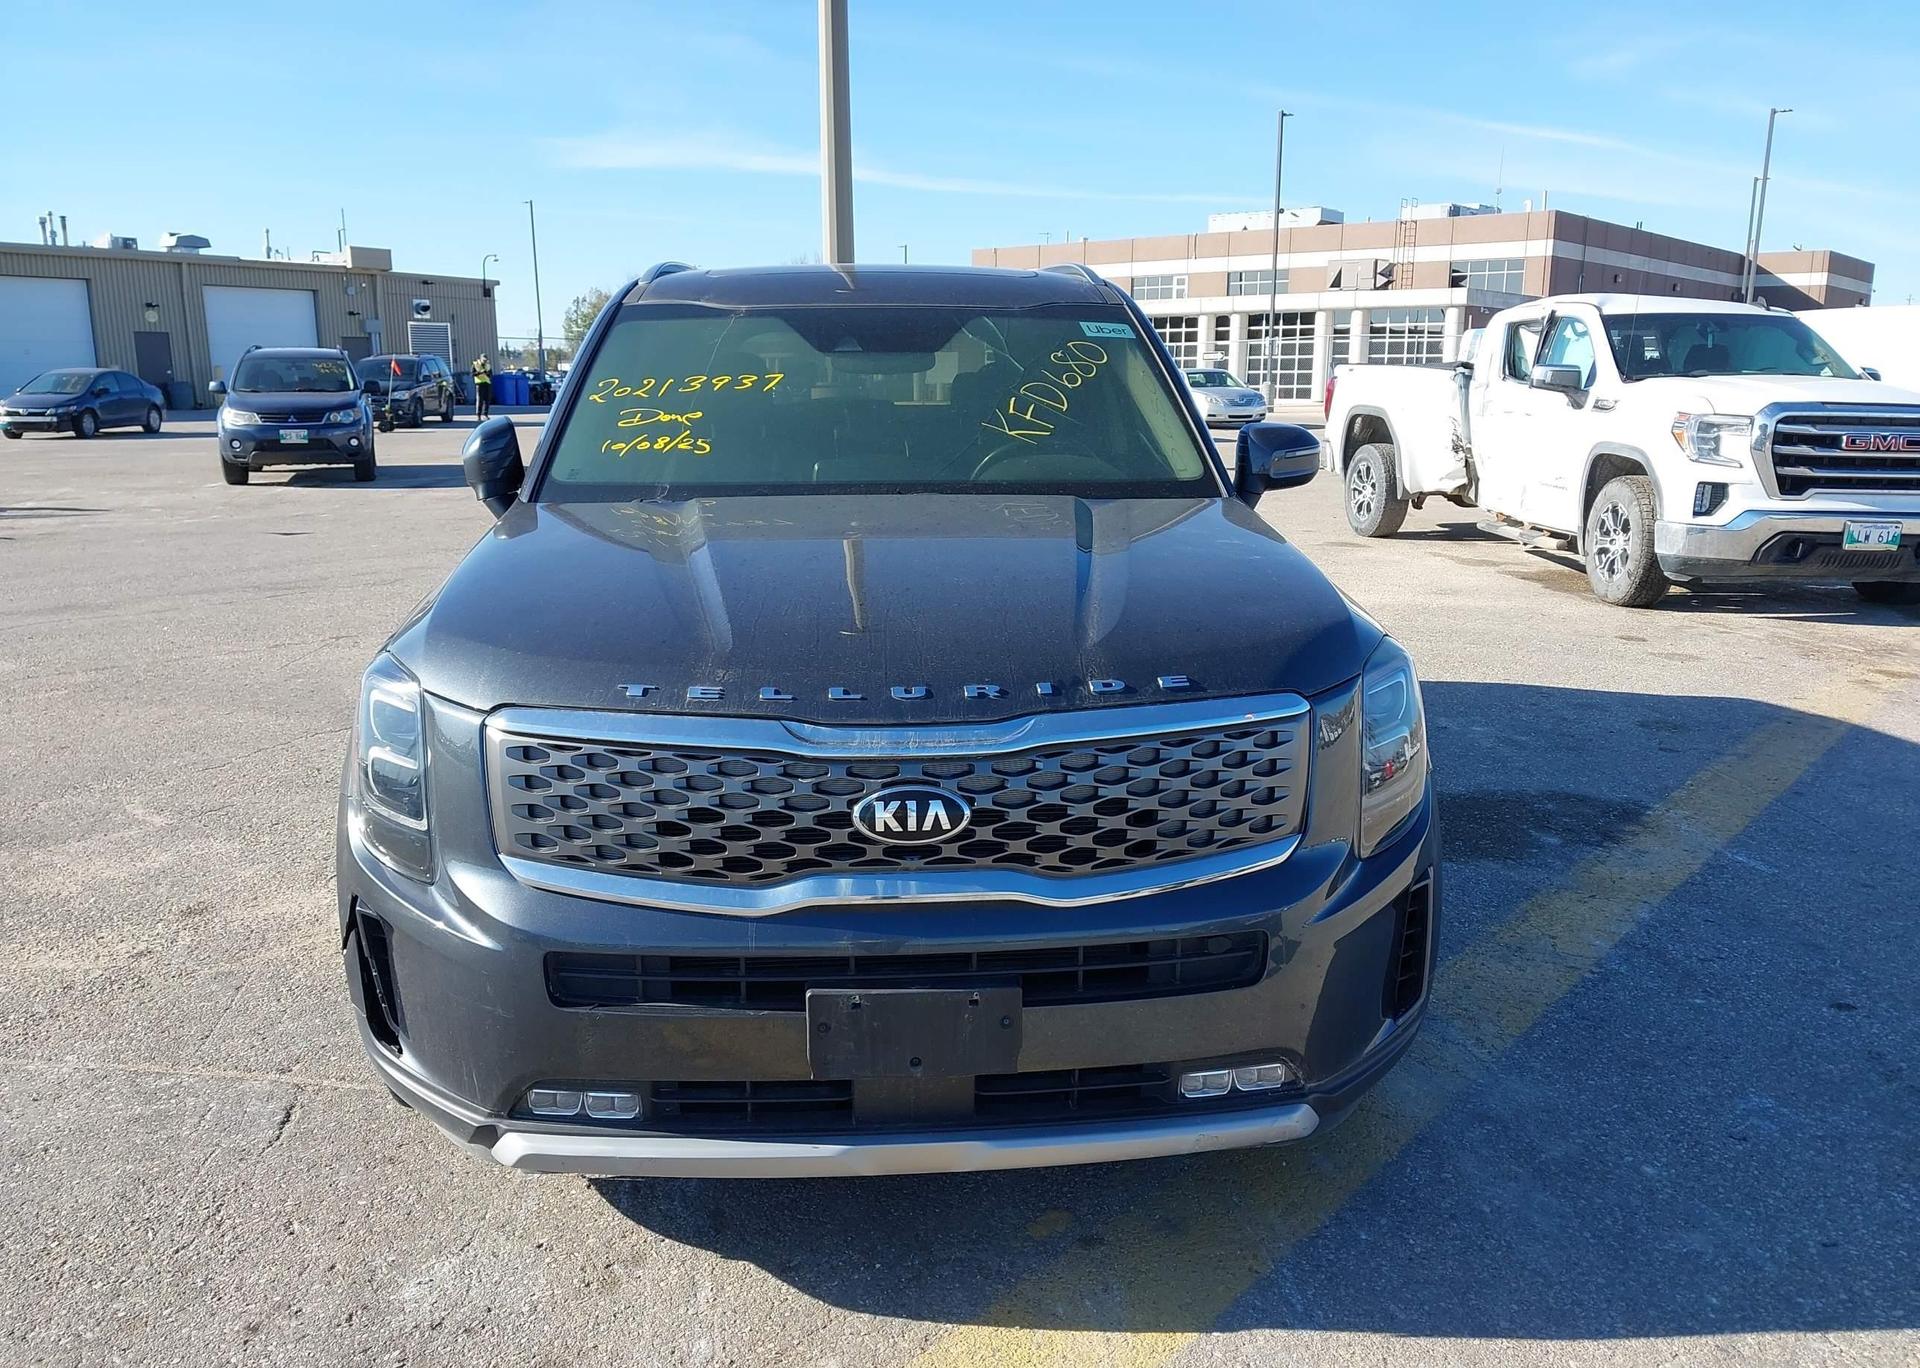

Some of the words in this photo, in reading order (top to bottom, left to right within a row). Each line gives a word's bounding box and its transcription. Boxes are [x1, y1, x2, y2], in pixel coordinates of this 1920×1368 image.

[1085, 324, 1128, 336] Uber
[588, 373, 785, 403] 20213937
[981, 341, 1108, 445] KFD680
[617, 408, 703, 427] Done
[601, 430, 711, 457] 10/08/25
[1842, 434, 1920, 451] GMC
[617, 674, 1191, 703] TELLURIDE
[873, 800, 952, 832] KIA
